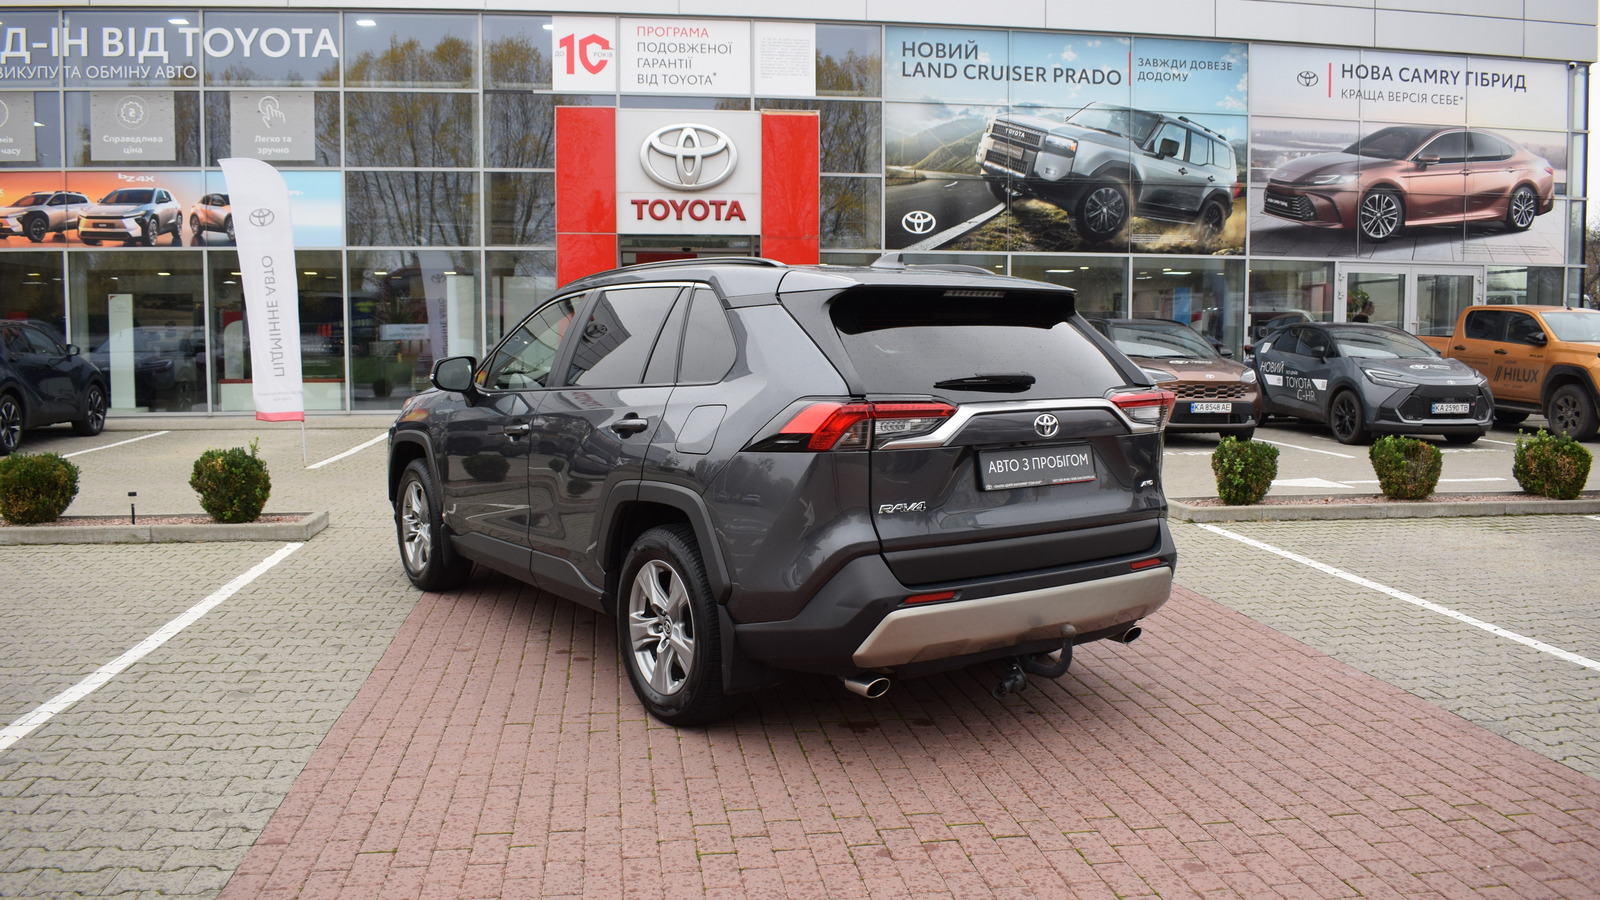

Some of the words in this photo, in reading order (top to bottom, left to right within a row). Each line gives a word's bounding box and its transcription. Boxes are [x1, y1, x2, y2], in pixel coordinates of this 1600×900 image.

[637, 26, 709, 38] ПРОГРАМА
[102, 27, 169, 64] ВІД
[178, 27, 340, 58] TOYOTA
[637, 42, 733, 54] ПОДОВЖЕНОЇ
[902, 40, 978, 60] НОВИЙ
[637, 56, 693, 69] ГАРАНТІЇ
[1138, 58, 1187, 69] ЗАВЖДИ
[1190, 60, 1232, 71] ДОВЕЗЕ
[63, 65, 81, 79] ТА
[86, 65, 150, 79] ОБМІНУ
[155, 65, 197, 79] АВТО
[902, 61, 958, 79] LAND
[963, 64, 1047, 81] CRUISER
[1053, 67, 1122, 85] PRADO
[1138, 71, 1189, 82] ДОДОМУ
[1341, 63, 1394, 81] НОВА
[1399, 67, 1460, 86] CAMRY
[1466, 71, 1527, 93] ГІБРИД
[637, 74, 659, 86] ВІД
[1341, 89, 1385, 102] КРАЩА
[1388, 91, 1428, 104] ВЕРСІЯ
[103, 135, 163, 144] Справедлива
[254, 135, 281, 143] Легко
[1005, 128, 1025, 138] TOYOTA
[631, 199, 747, 221] TOYOTA
[1260, 361, 1285, 374] НОВИЙ
[1503, 366, 1540, 383] HILUX
[1285, 376, 1312, 389] TOYOTA
[1297, 389, 1316, 401] C-HR
[988, 459, 1020, 474] АВТО
[1032, 453, 1089, 470] ПРОБІГОМ
[879, 501, 927, 514] RAV4
